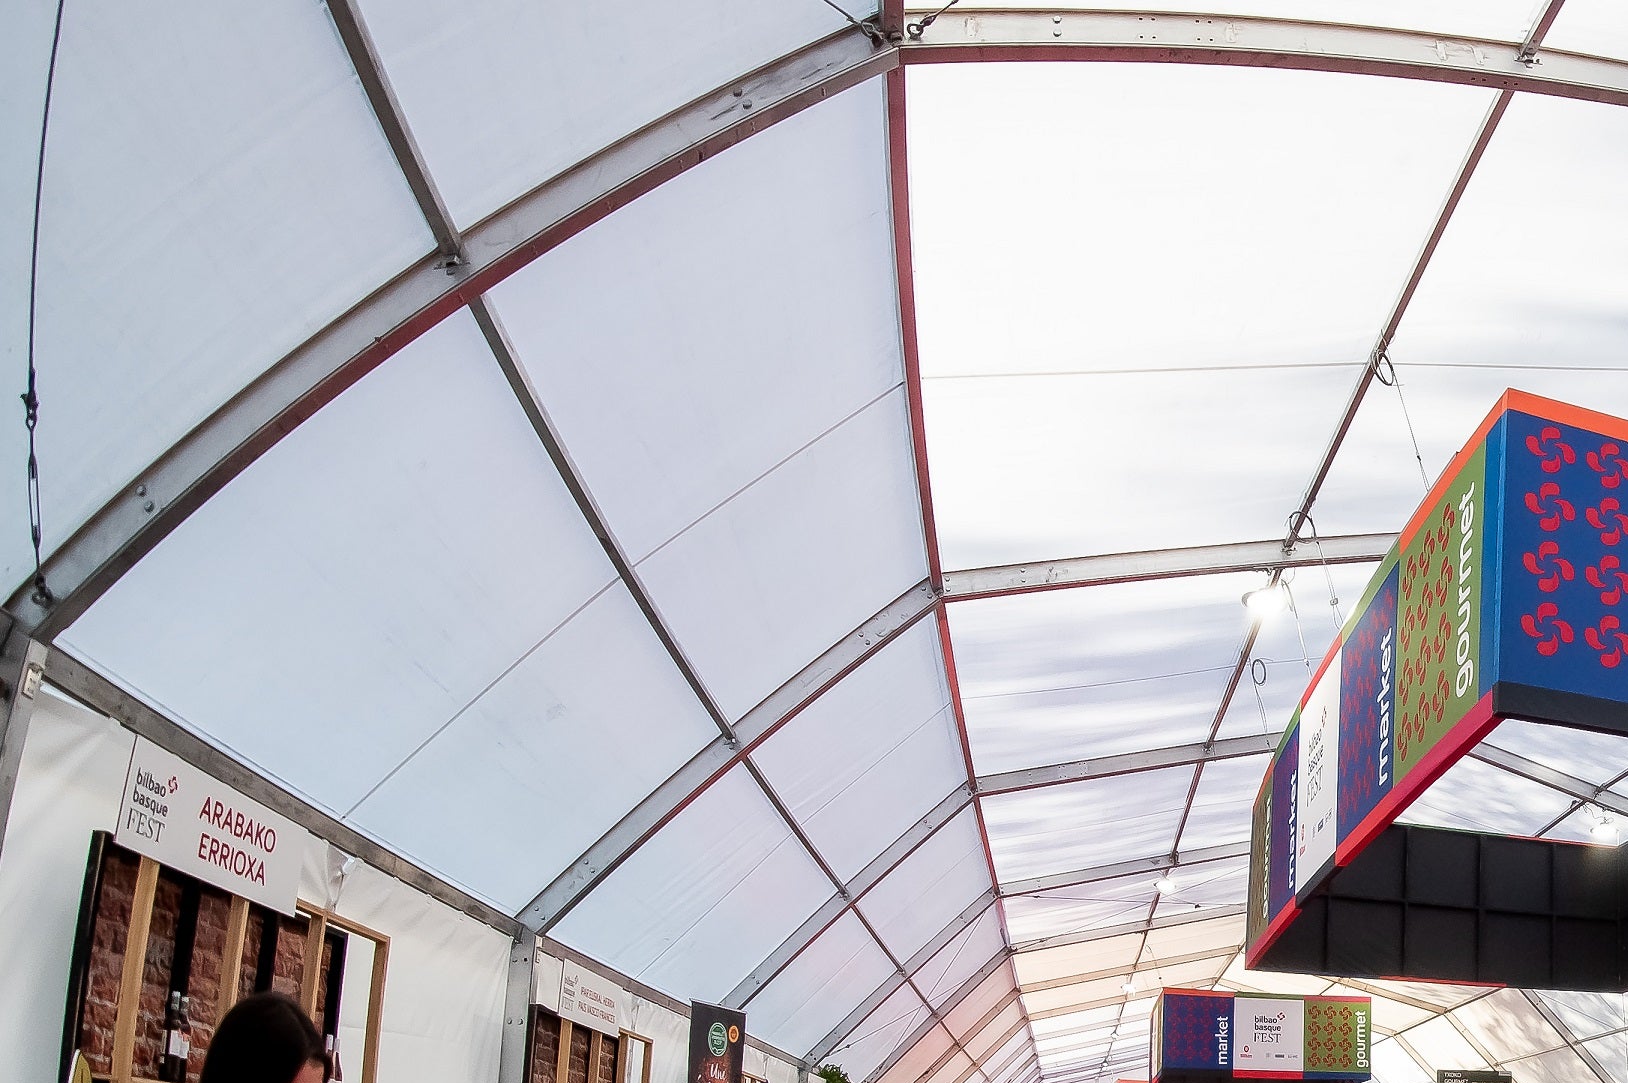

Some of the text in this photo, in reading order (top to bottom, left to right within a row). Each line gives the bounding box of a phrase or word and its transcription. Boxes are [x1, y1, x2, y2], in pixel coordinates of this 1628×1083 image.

[1456, 481, 1475, 698] gourmet
[1376, 627, 1393, 786] market
[132, 785, 169, 818] basque
[136, 767, 167, 798] bilbao
[126, 807, 166, 844] FEST
[199, 796, 277, 854] ARABAKO
[1288, 770, 1298, 888] market
[198, 832, 266, 887] ERRIOXA
[1215, 1016, 1229, 1065] market
[1253, 1032, 1282, 1044] FEST
[1254, 1015, 1278, 1024] bilbao
[1254, 1023, 1282, 1032] basque
[1356, 1010, 1369, 1068] gourmet
